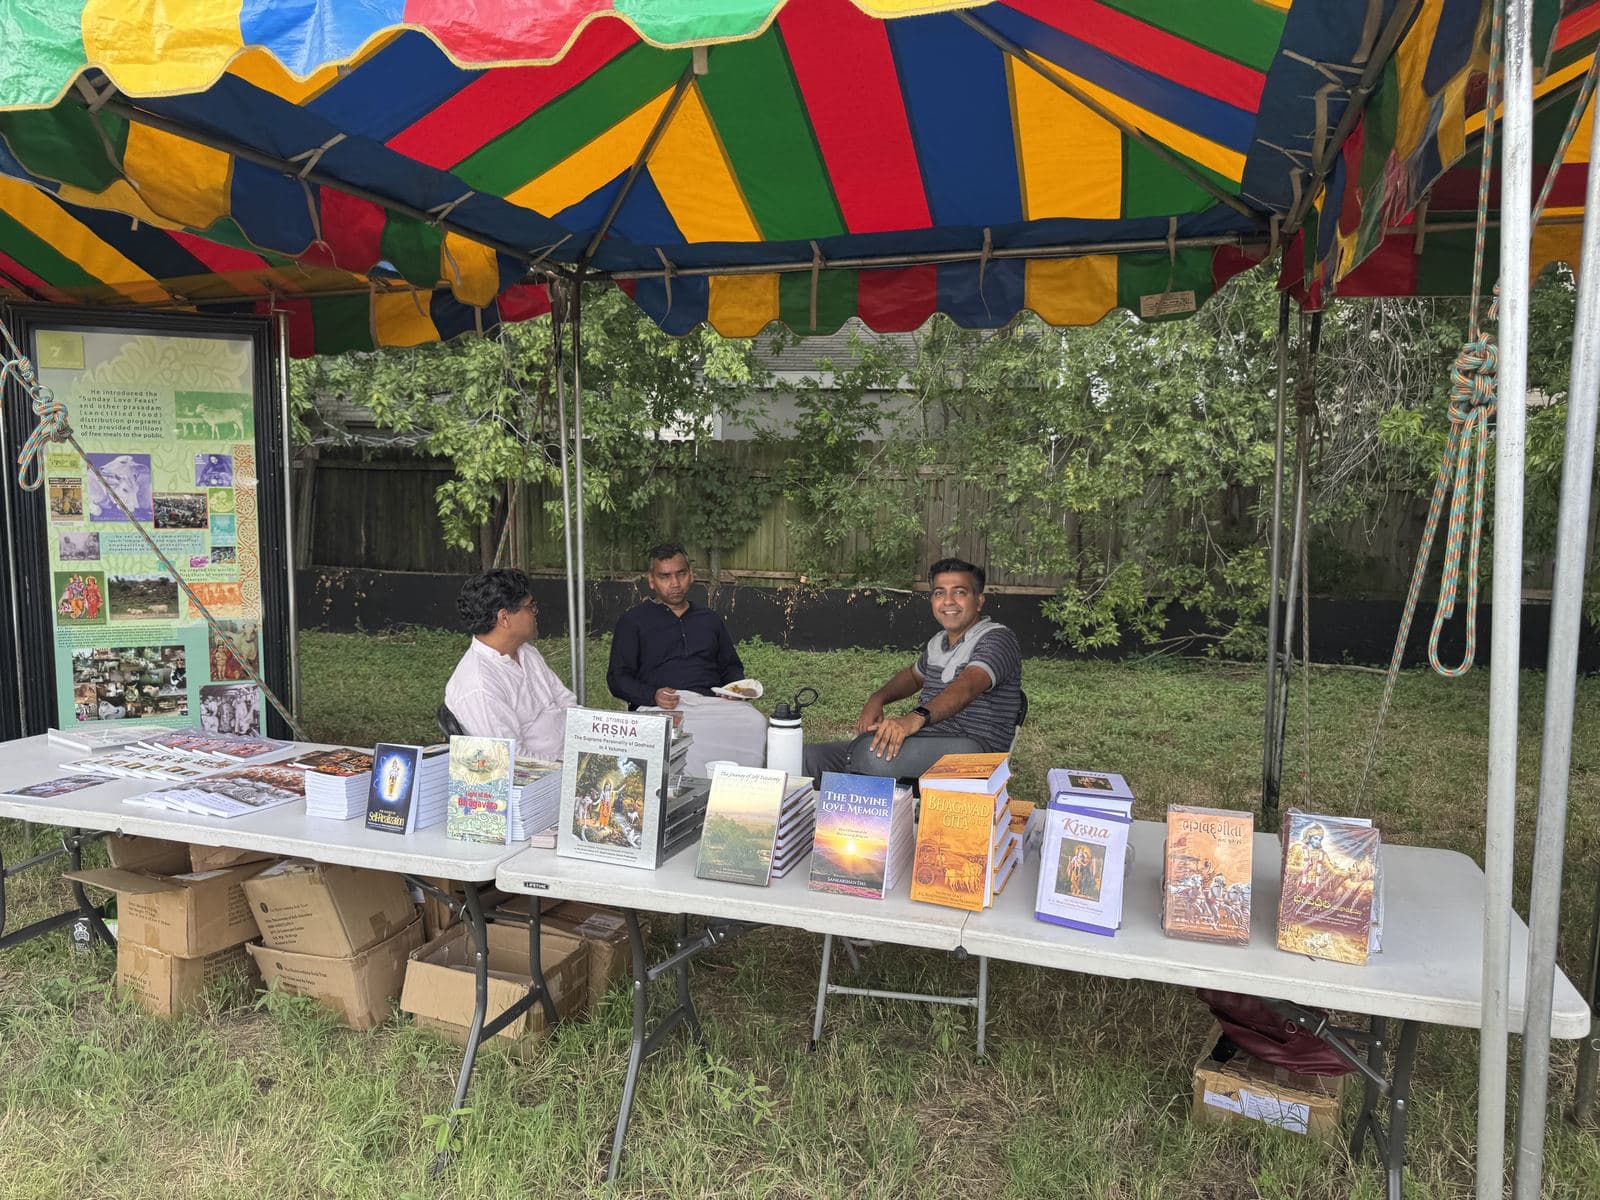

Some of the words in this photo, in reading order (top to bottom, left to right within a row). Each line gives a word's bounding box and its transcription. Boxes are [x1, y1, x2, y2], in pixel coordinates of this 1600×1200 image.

[102, 389, 144, 397] introduced
[606, 716, 629, 725] STORIES
[583, 735, 603, 743] Supreme
[603, 737, 628, 747] Personality
[634, 741, 656, 749] Godhead
[608, 745, 628, 753] Volumes
[927, 794, 990, 818] BHAGAVAD
